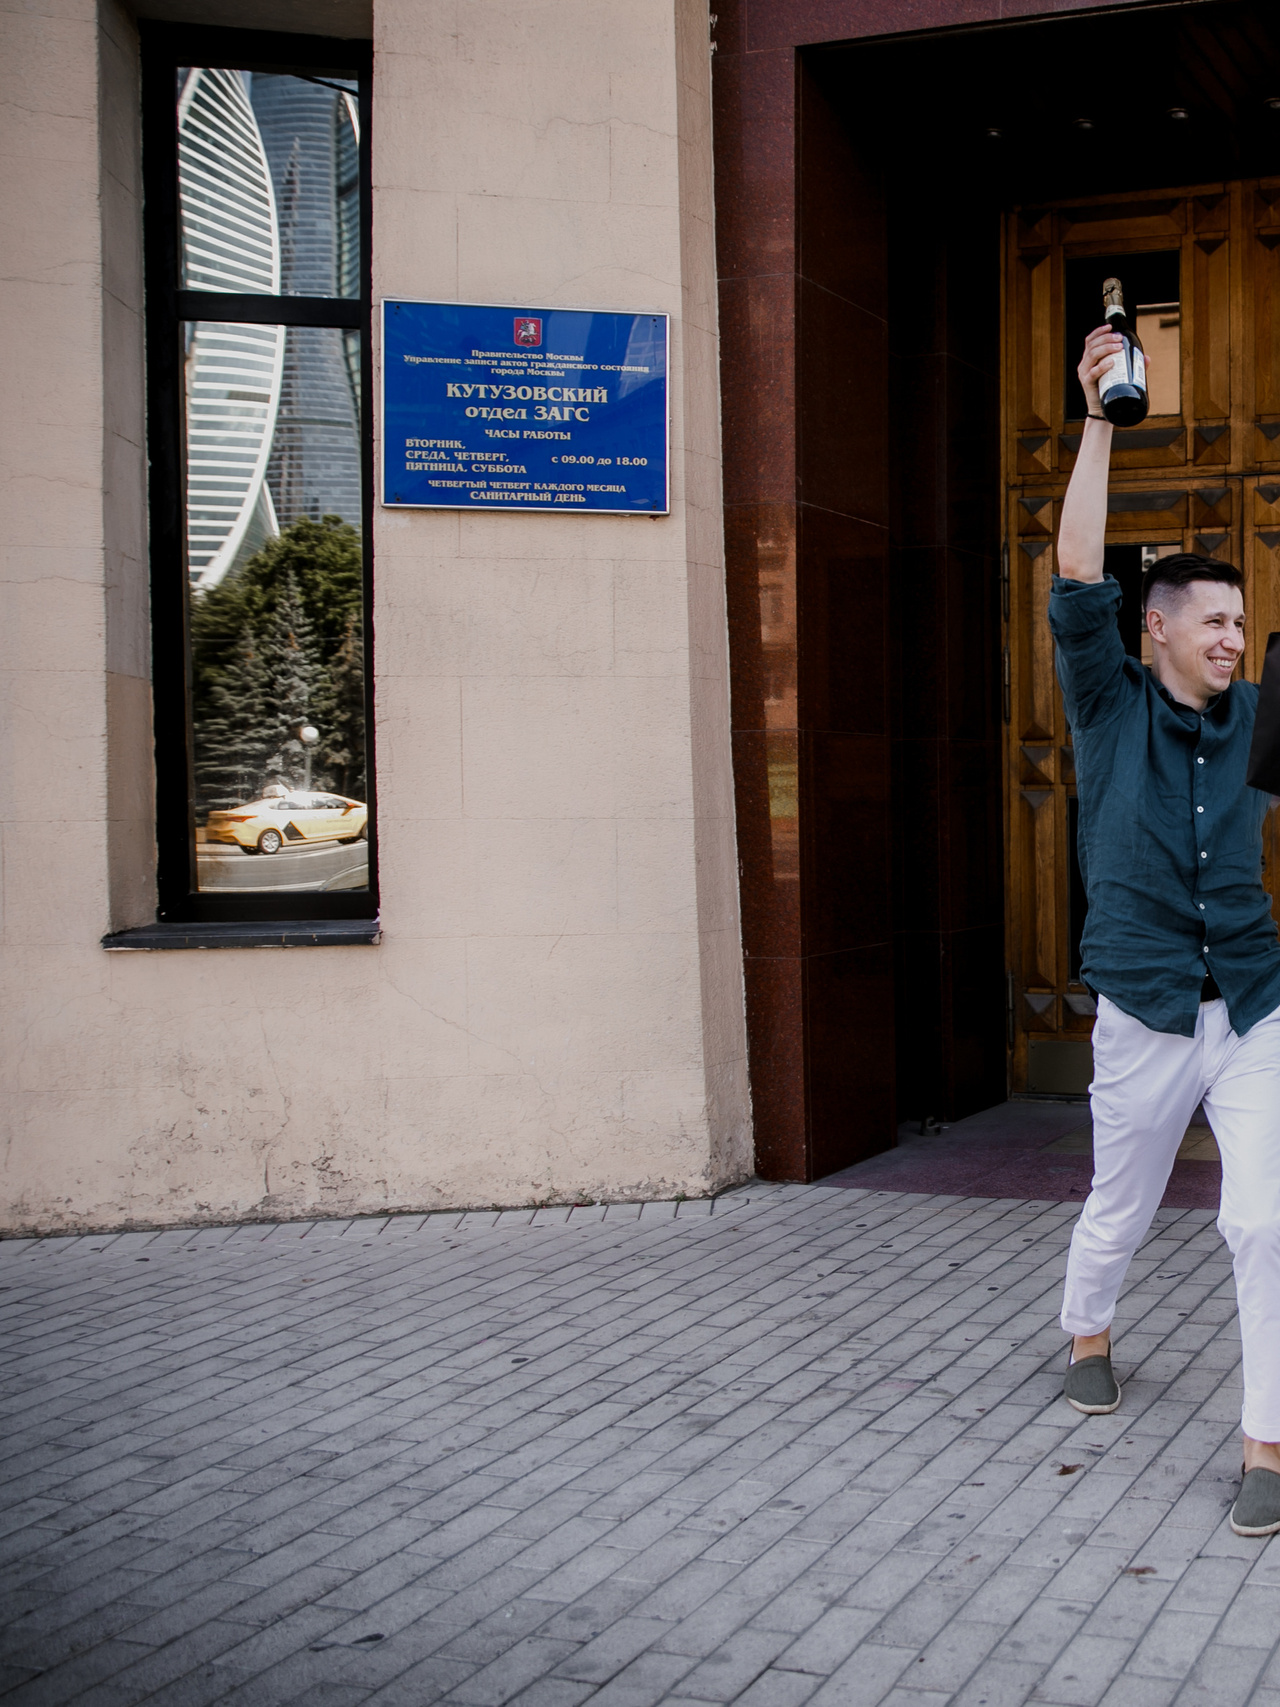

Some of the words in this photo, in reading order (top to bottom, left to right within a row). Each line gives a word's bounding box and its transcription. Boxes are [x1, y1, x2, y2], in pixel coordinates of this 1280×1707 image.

[403, 354, 462, 365] Управление
[464, 358, 498, 366] записи
[500, 359, 528, 367] актов
[530, 361, 598, 370] гражданского
[471, 349, 544, 360] Правительство
[545, 352, 584, 362] Москвы
[491, 367, 525, 376] города
[526, 368, 565, 377] Москвы
[446, 382, 608, 404] КУТУЗОВСКИЙ
[465, 406, 528, 422] отдел
[533, 405, 590, 422] ЗАГС
[484, 429, 520, 439] ЧАСЫ
[523, 430, 571, 440] РАБОТЫ
[405, 438, 466, 449] ВТОРНИК,
[405, 450, 450, 461] СРЕДА,
[453, 451, 510, 463] ЧЕТВЕРГ,
[551, 455, 559, 464] с
[560, 454, 595, 465] 09.00
[596, 457, 612, 466] до
[616, 456, 648, 467] 18.00
[405, 461, 468, 473] ПЯТНИЦА,
[471, 463, 528, 474] СУББОТА
[428, 479, 487, 489] ЧЕТВЕРТЫЙ
[489, 481, 532, 490] ЧЕТВЕРГ
[534, 482, 585, 492] КАЖДОГО
[586, 484, 626, 493] МЕСЯЦА
[470, 490, 552, 502] САНИТАРНЫЙ
[553, 493, 586, 503] ДЕНЬ
